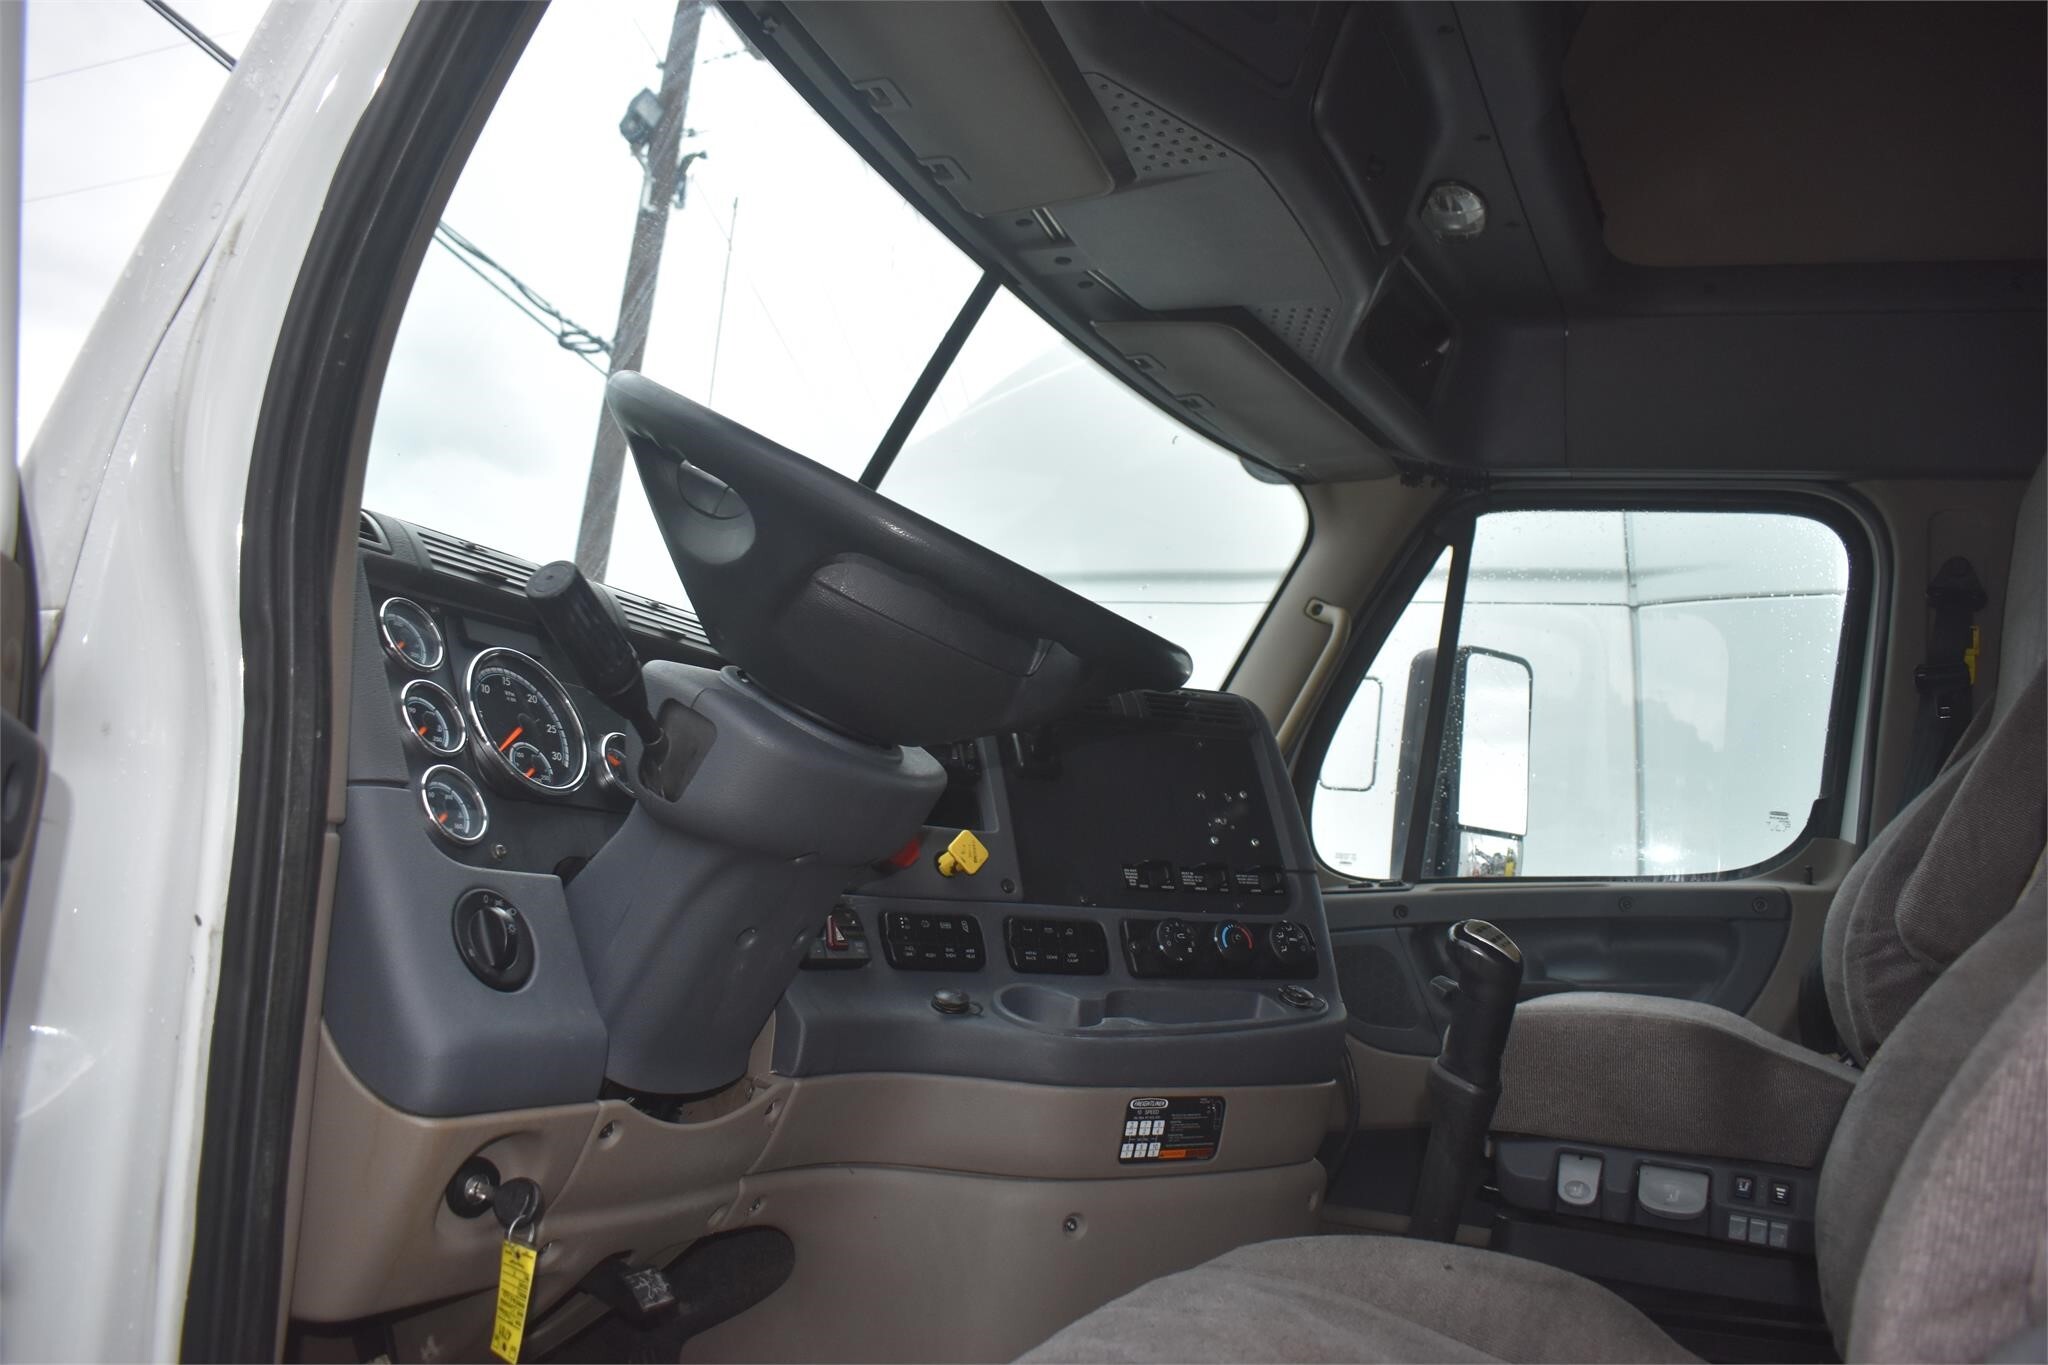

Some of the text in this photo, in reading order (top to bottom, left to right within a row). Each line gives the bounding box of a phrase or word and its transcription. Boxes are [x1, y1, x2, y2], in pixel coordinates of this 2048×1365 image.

[502, 676, 511, 686] 15
[481, 684, 491, 694] 10
[527, 694, 538, 704] 20
[546, 724, 557, 734] 25
[551, 751, 562, 761] 30
